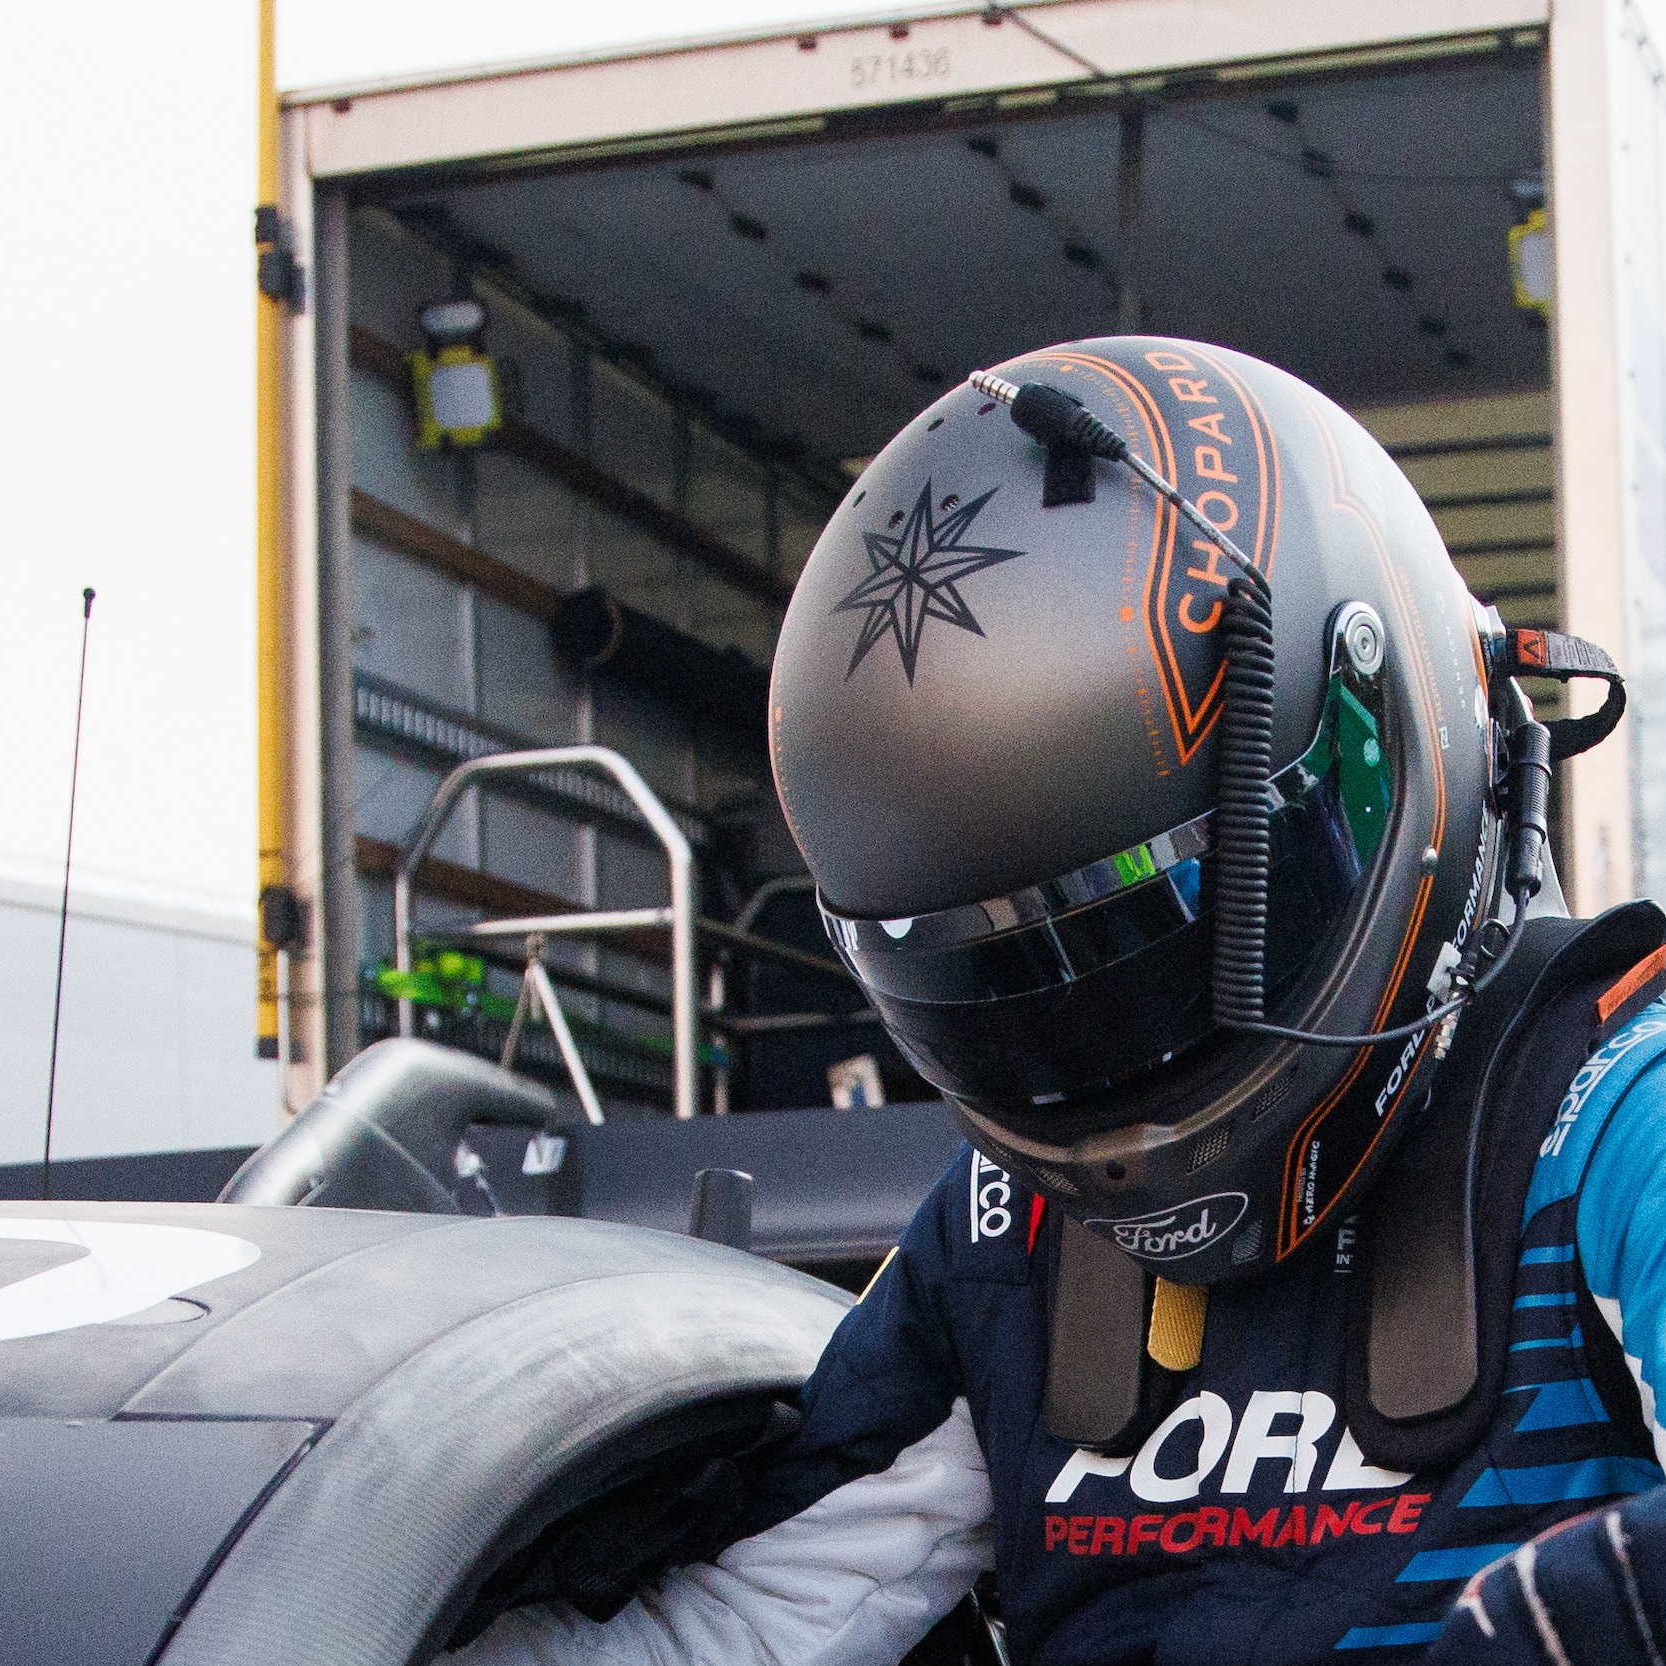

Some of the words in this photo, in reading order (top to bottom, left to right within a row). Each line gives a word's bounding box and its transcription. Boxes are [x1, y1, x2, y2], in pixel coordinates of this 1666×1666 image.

[1144, 349, 1239, 635] CHOPARD
[973, 1151, 1011, 1241] rco
[1113, 1207, 1217, 1253] Ford
[1044, 1493, 1432, 1556] PERFORMANCE
